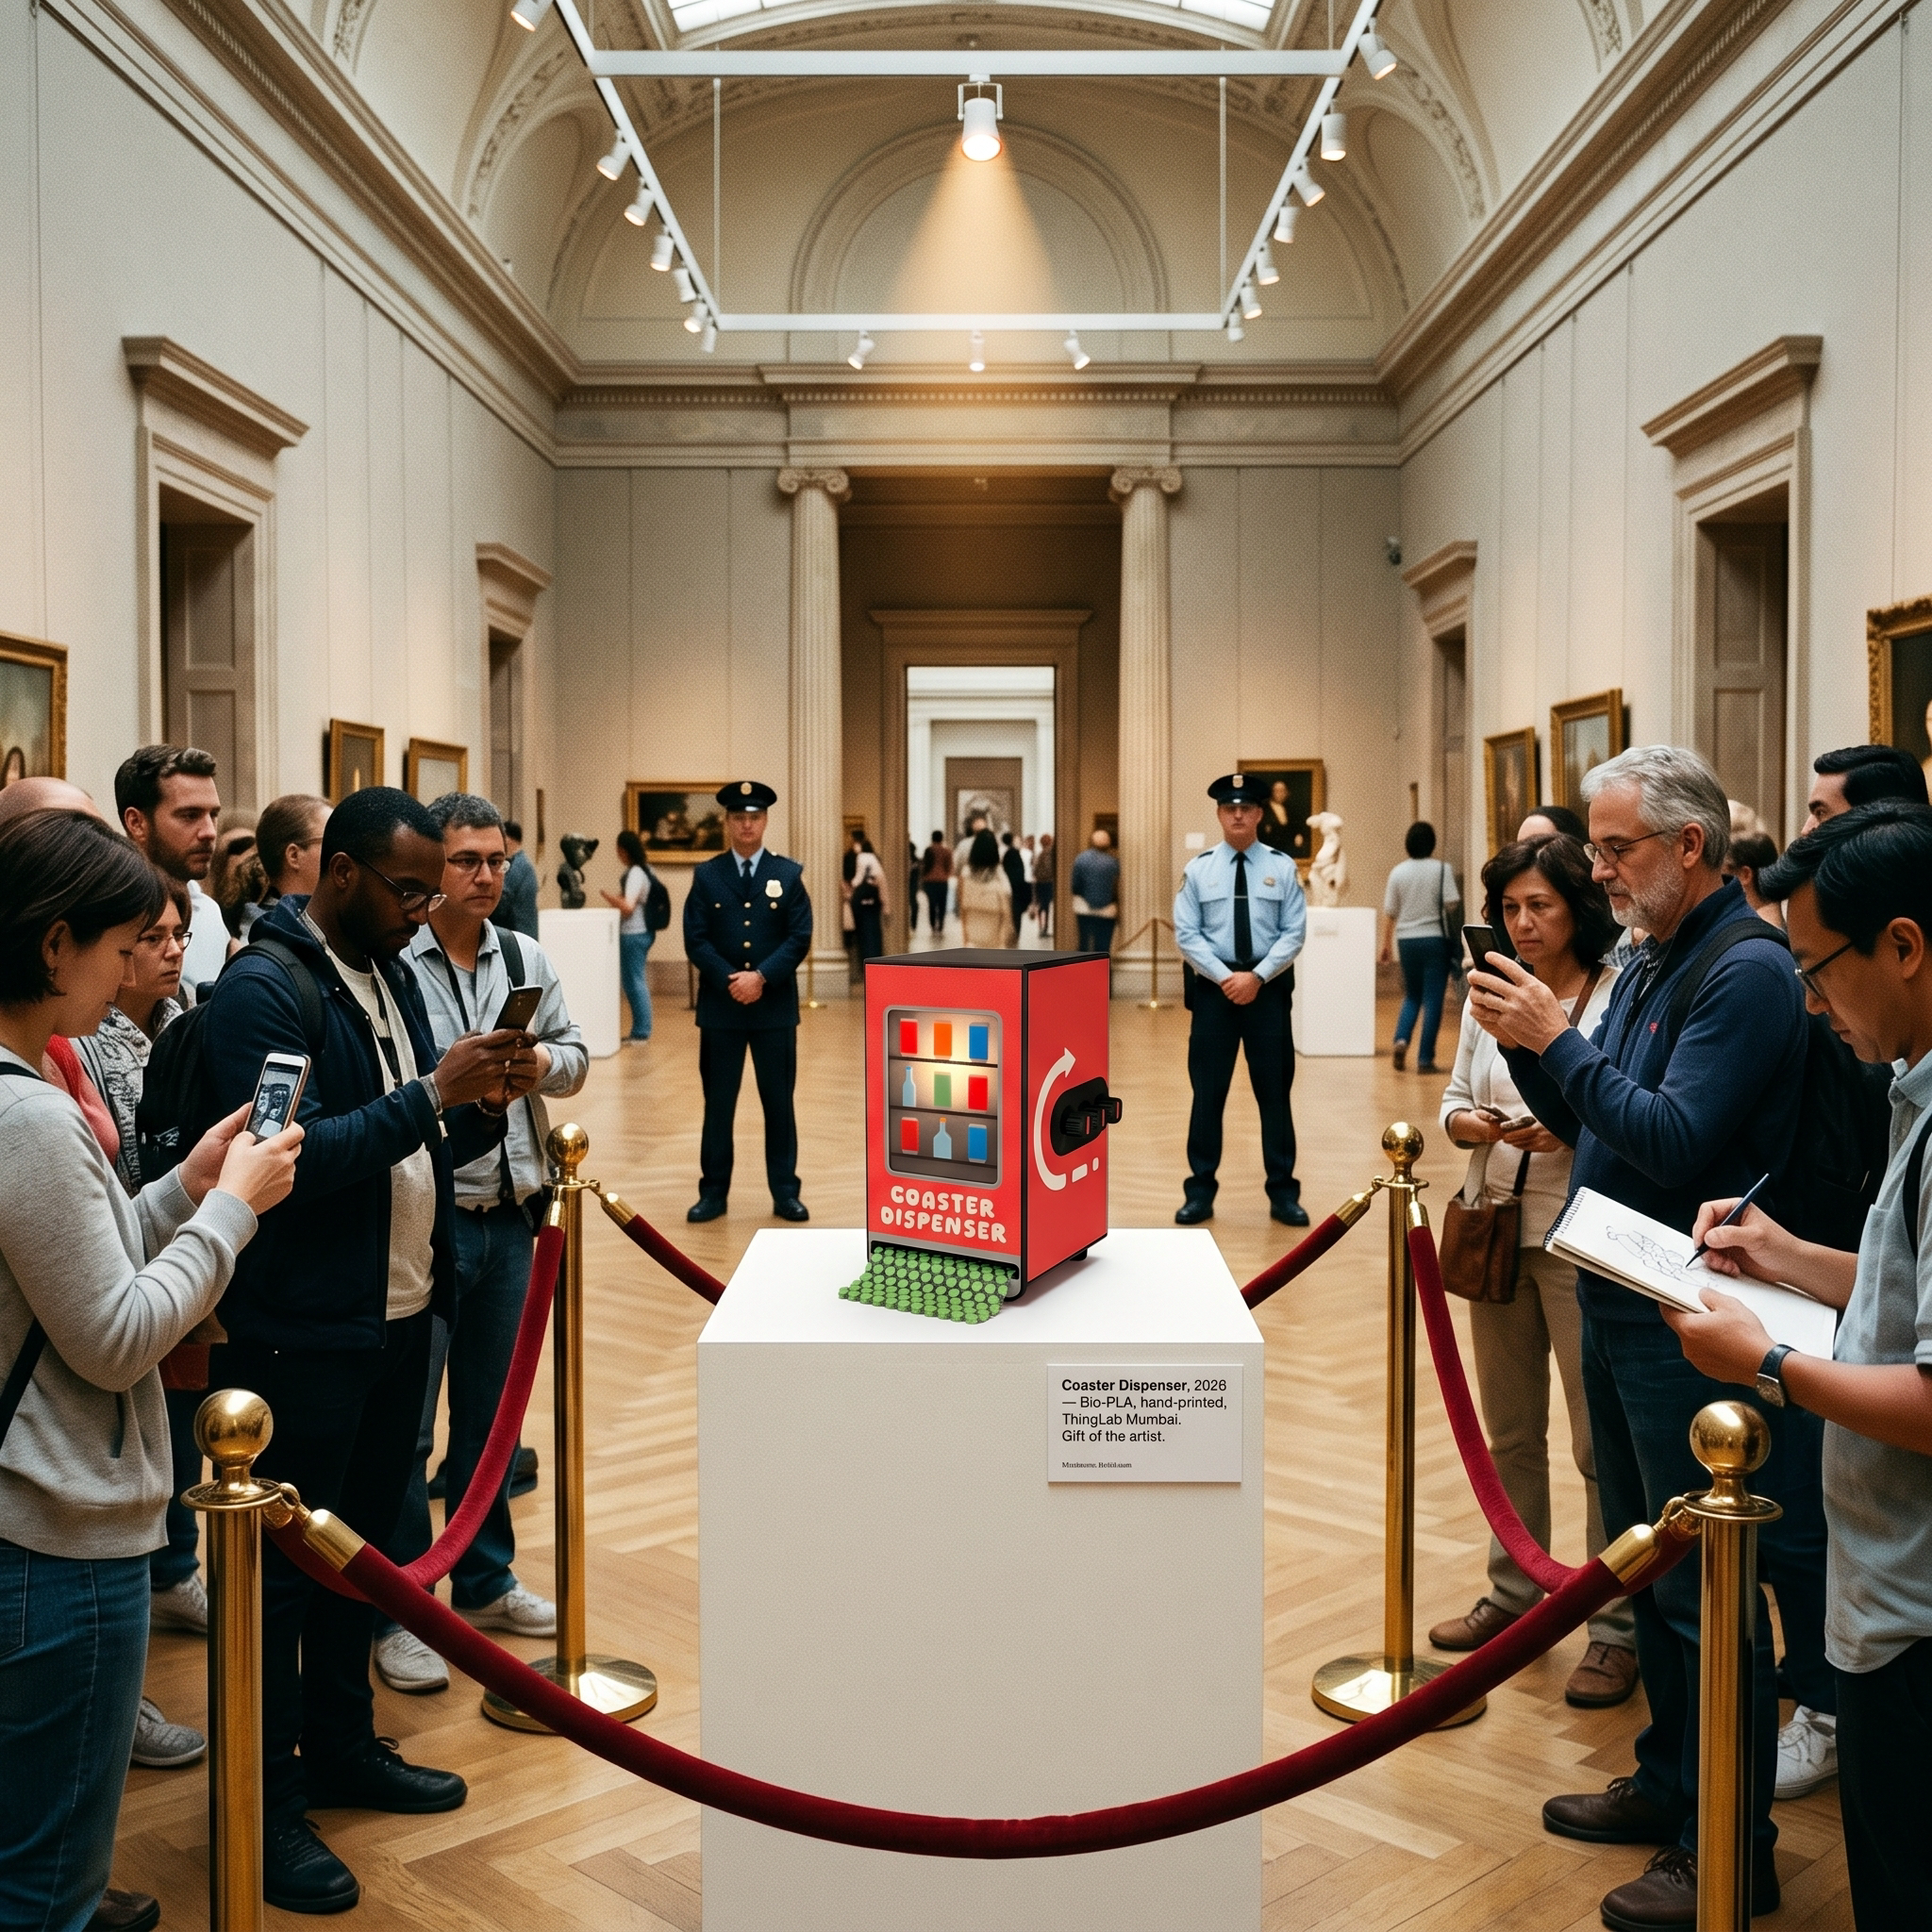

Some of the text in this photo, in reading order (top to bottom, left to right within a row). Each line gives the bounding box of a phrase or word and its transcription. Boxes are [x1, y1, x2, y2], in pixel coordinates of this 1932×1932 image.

[891, 1185, 995, 1218] COASTER
[880, 1206, 1007, 1243] DISPENSER
[1061, 1378, 1227, 1393] Coaster Dispenser, 2026
[1080, 1395, 1137, 1410] Bio-PLA,
[1141, 1395, 1227, 1411] hand-printed,
[1061, 1412, 1182, 1428] ThingLab Mumbai.
[1061, 1429, 1166, 1442] Gift of the artist.
